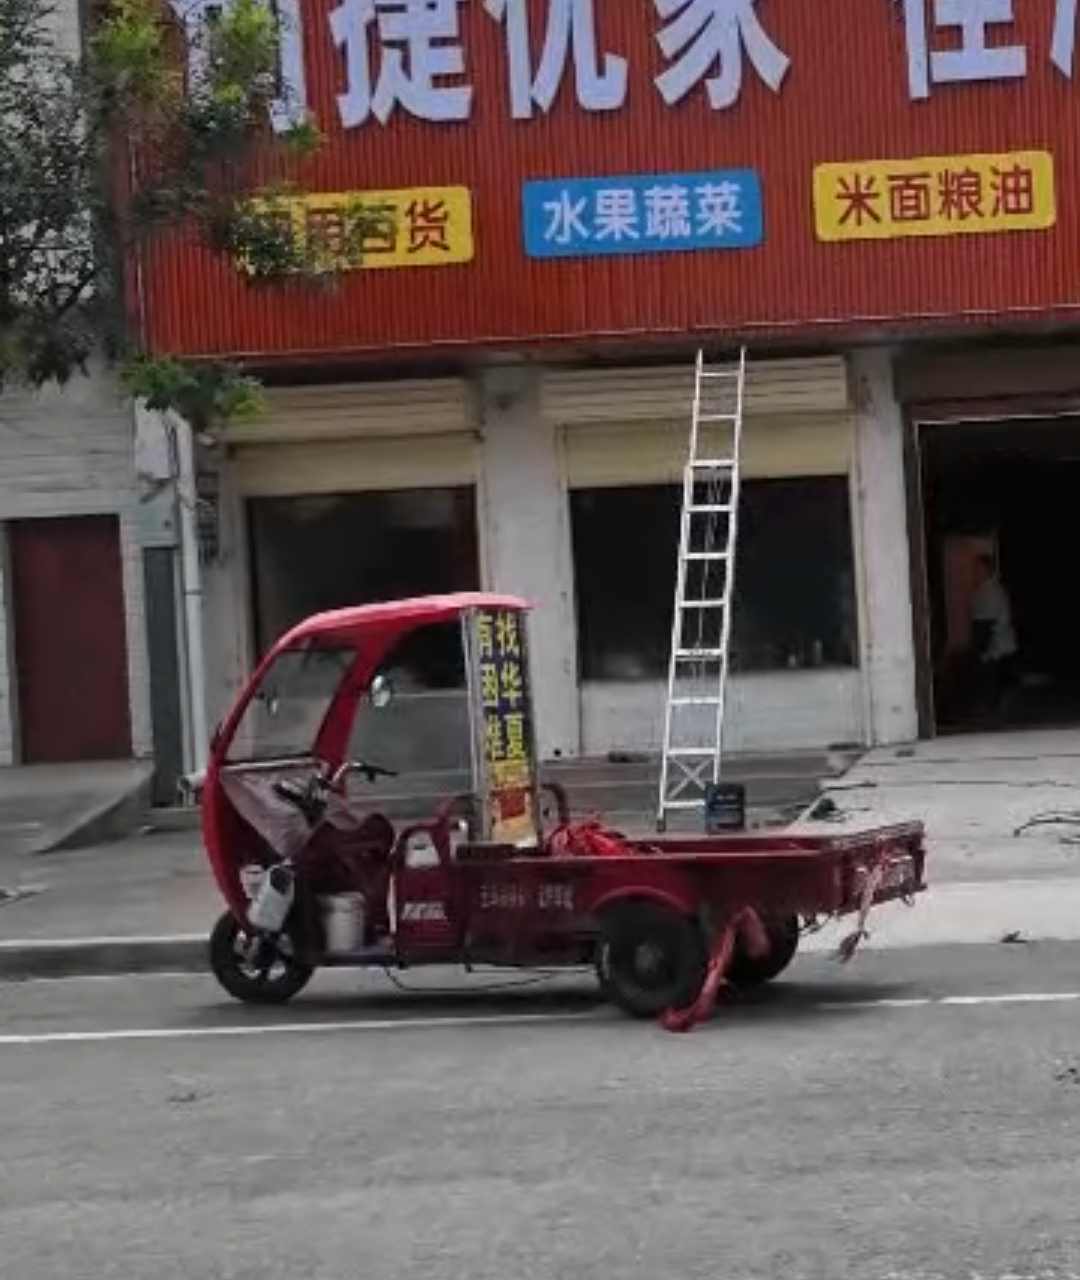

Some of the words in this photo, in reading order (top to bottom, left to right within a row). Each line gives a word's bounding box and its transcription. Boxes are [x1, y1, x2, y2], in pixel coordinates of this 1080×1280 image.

[541, 180, 743, 245] 水果蔬菜
[835, 164, 1035, 228] 米面粮油
